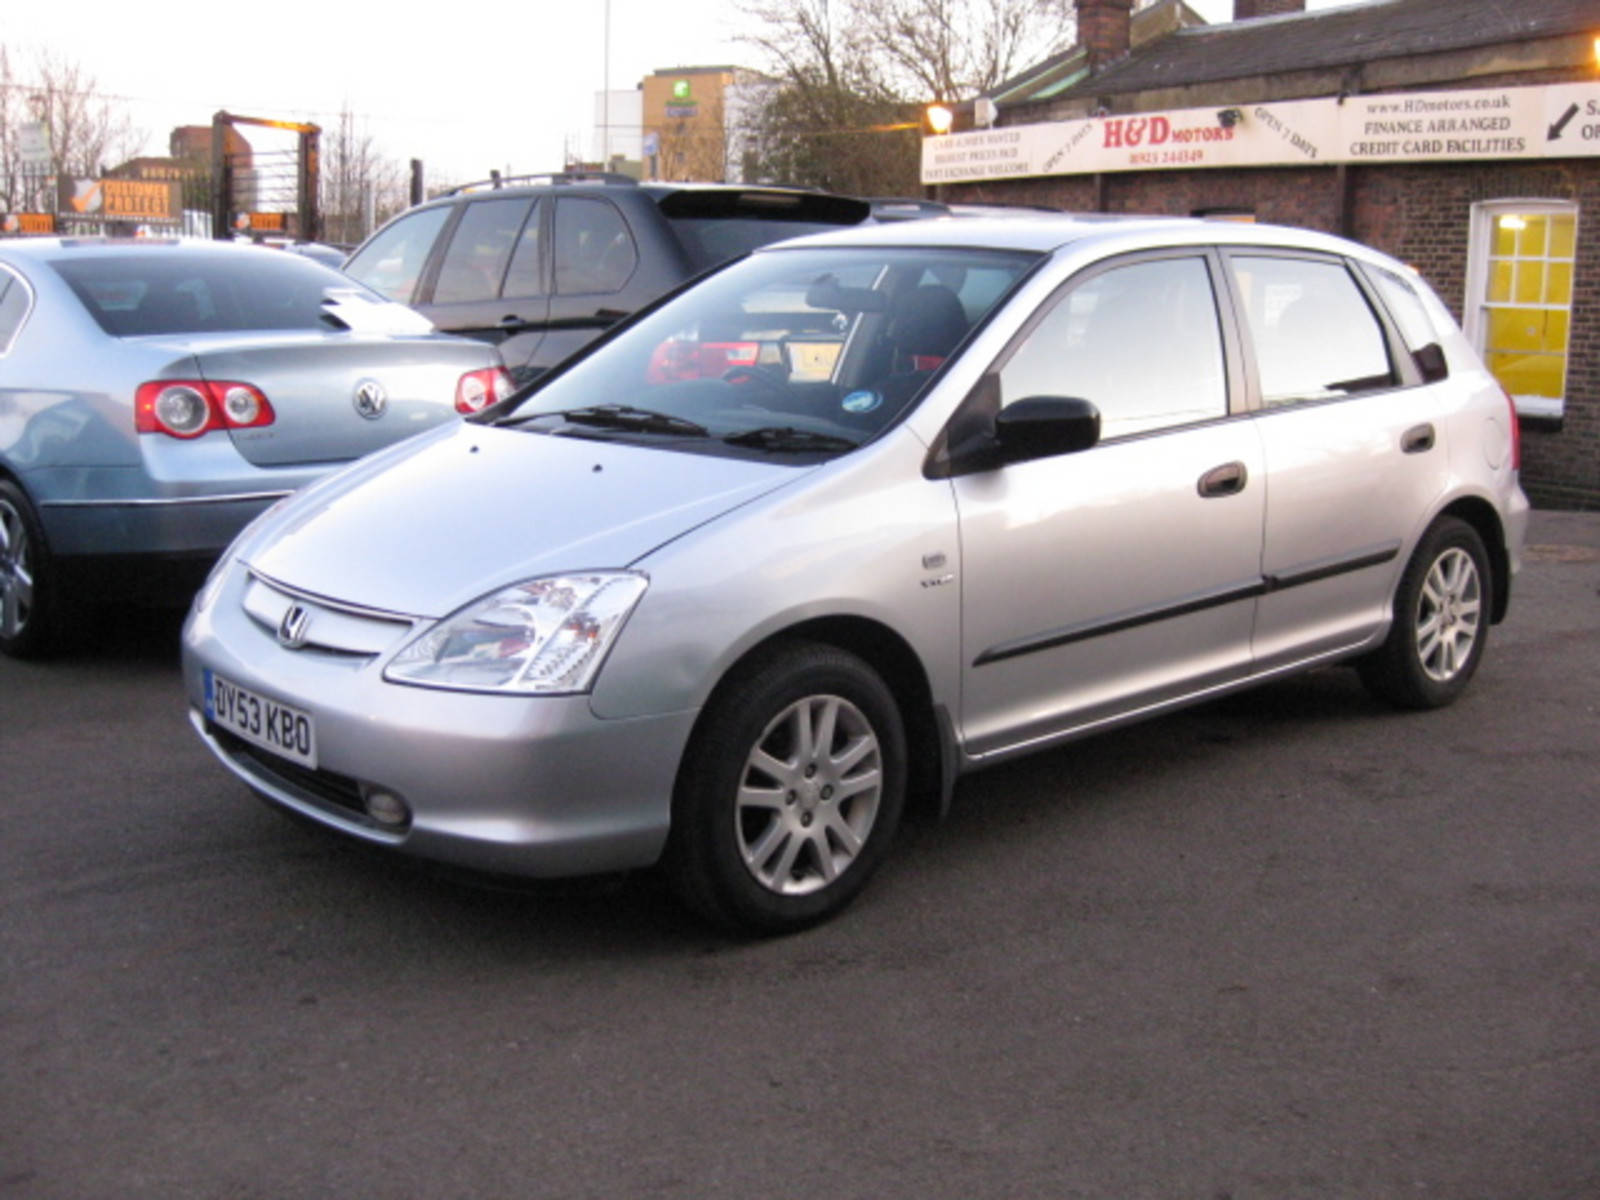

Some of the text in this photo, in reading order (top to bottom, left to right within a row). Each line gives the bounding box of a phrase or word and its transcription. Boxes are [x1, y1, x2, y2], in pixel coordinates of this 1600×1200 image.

[1103, 116, 1234, 148] H&D MOTORS
[1254, 106, 1282, 132] OPEN
[1290, 132, 1317, 158] DAYS
[1364, 116, 1511, 135] FINANCE ARRANGED
[1349, 136, 1526, 156] CREDIT CARD FACILITIES
[216, 680, 311, 757] DY53 KBO
